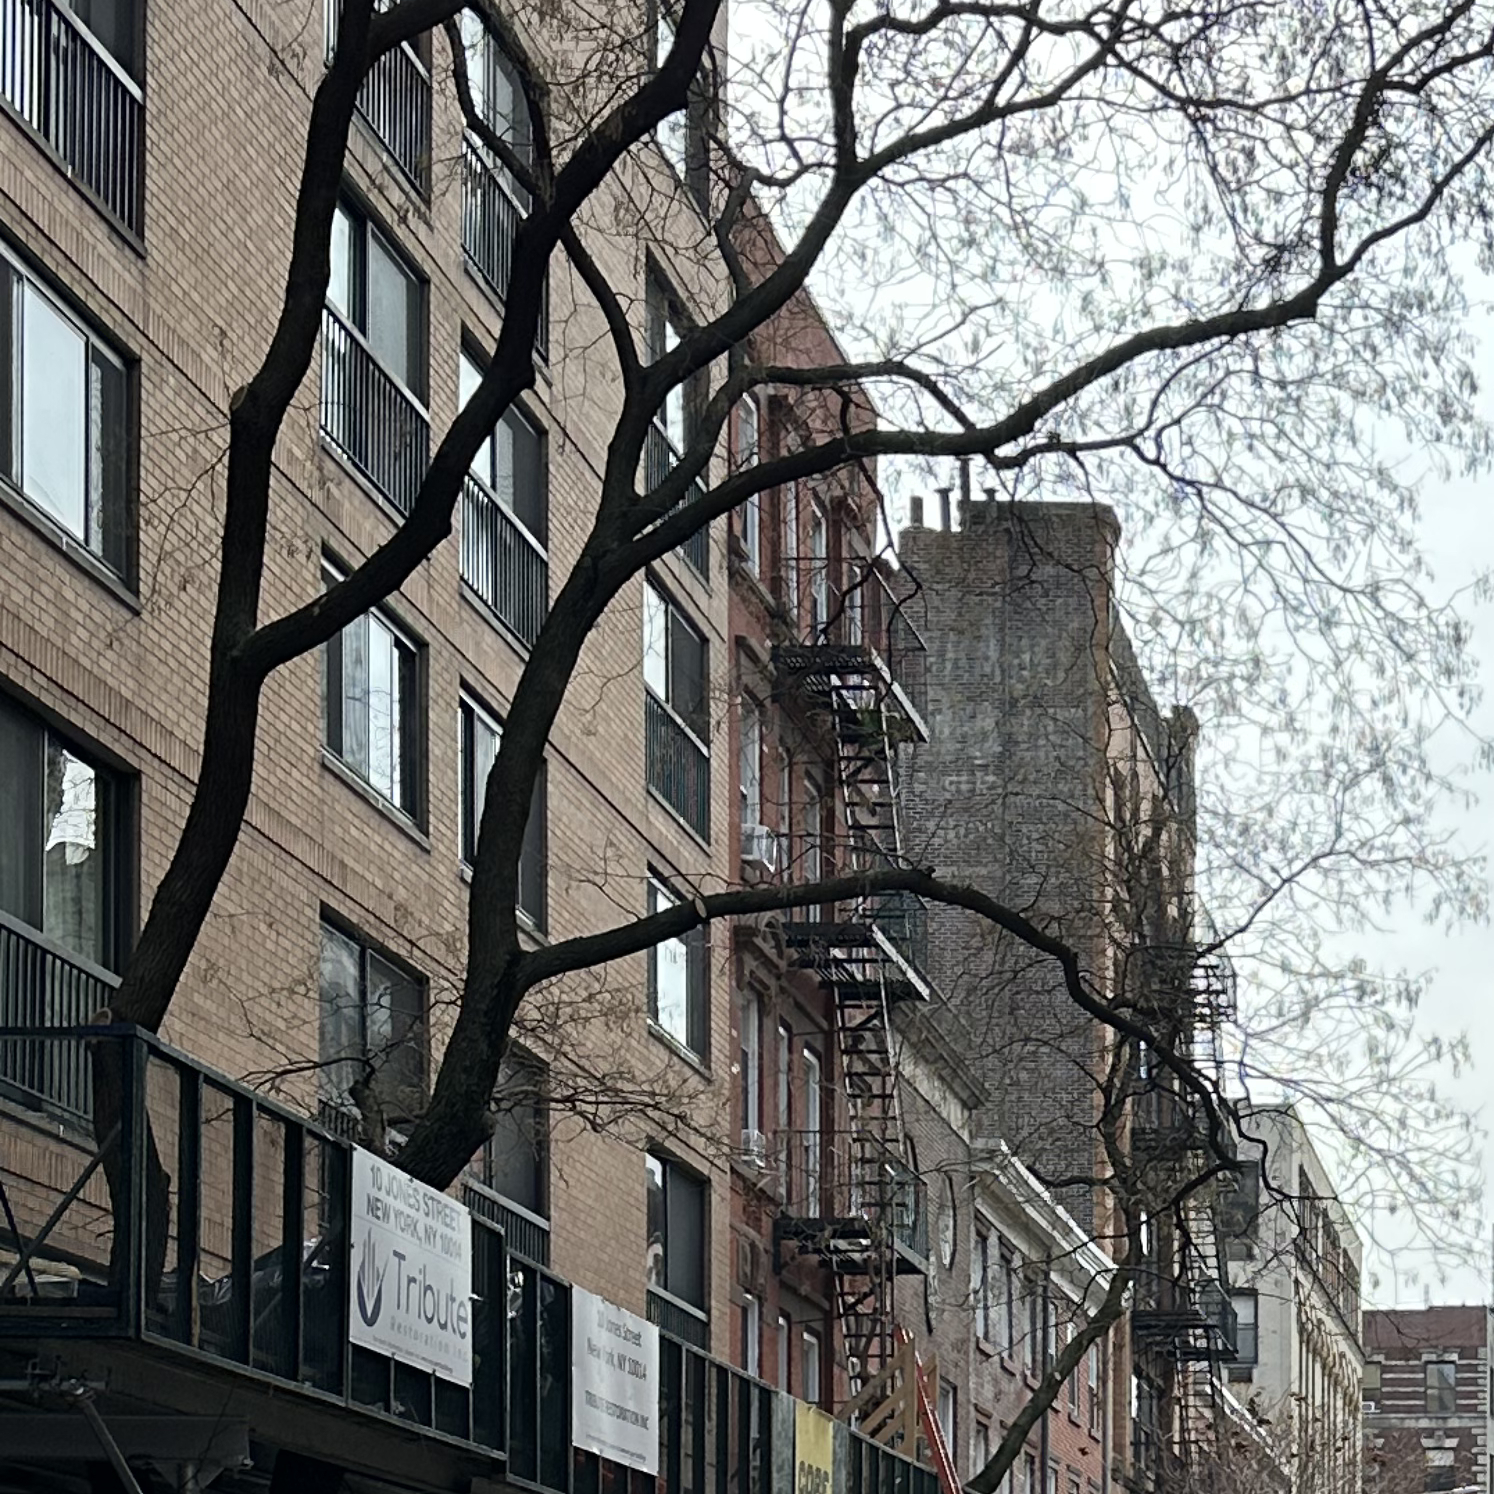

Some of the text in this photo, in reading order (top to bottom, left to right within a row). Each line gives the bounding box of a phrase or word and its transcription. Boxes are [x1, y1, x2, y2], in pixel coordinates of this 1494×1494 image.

[366, 1192, 391, 1224] NEW
[424, 1222, 438, 1249] NY
[370, 1163, 461, 1234] 10 JONES STREET
[392, 1249, 469, 1340] Tribute
